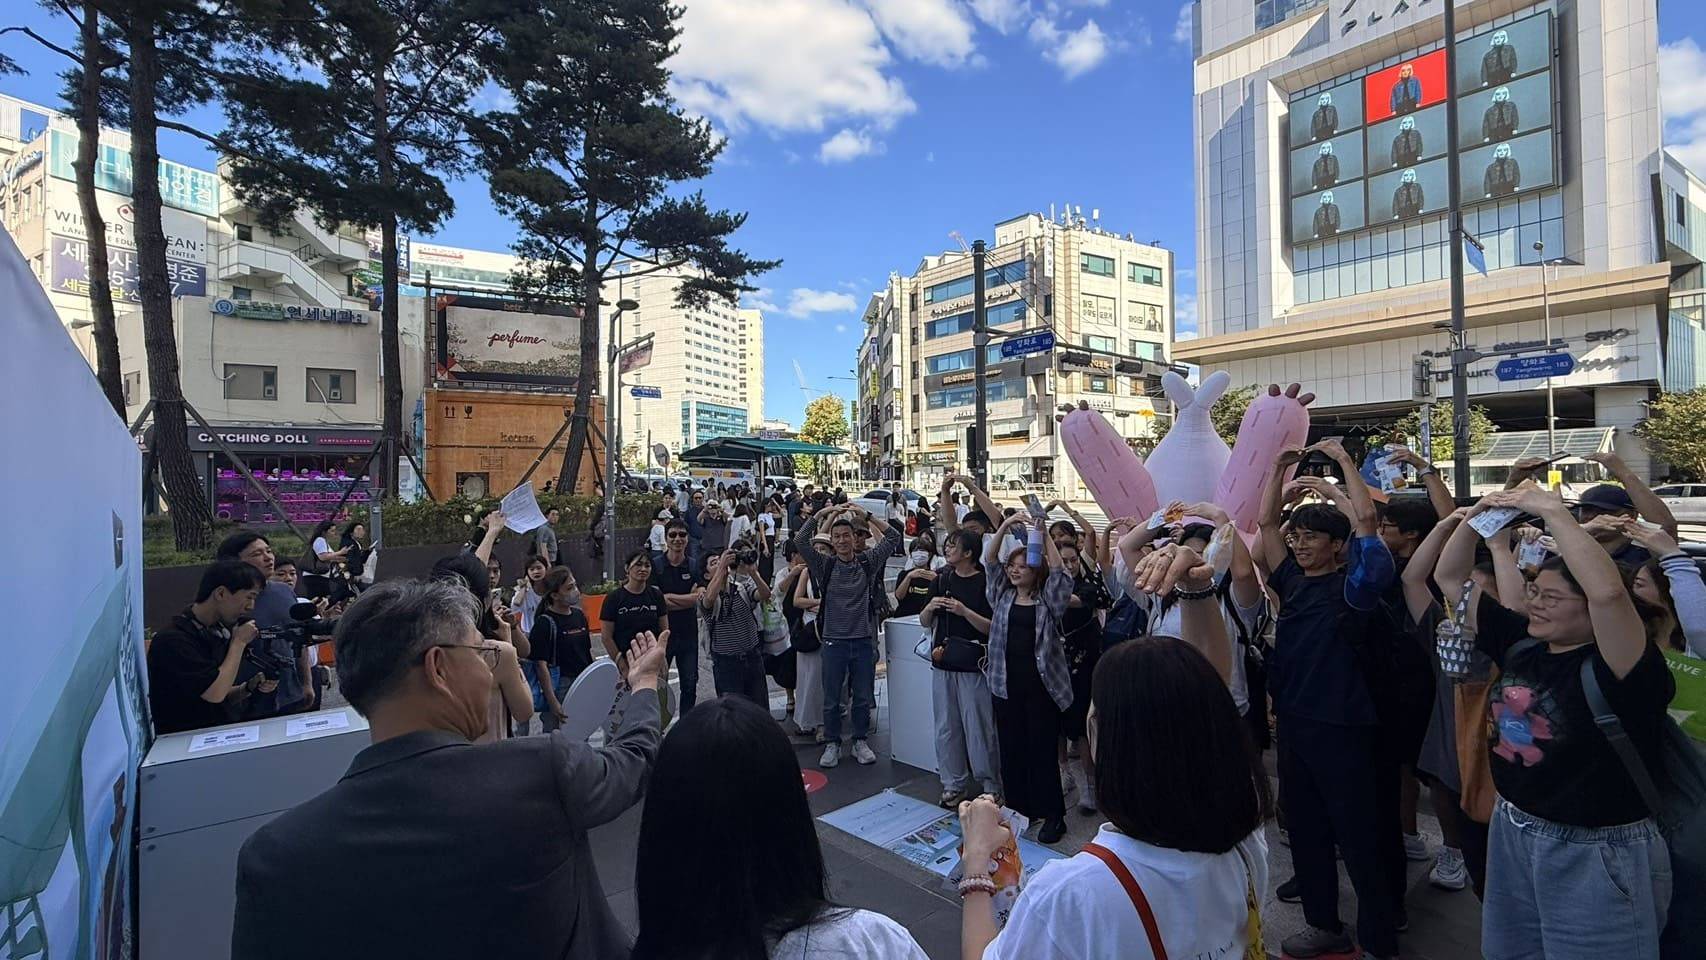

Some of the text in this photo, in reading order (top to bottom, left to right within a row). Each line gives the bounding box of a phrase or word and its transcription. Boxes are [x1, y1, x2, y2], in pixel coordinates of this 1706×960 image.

[55, 209, 125, 235] WIER
[487, 329, 547, 349] perfume
[1520, 358, 1547, 367] 양화로
[275, 434, 309, 444] DOLL
